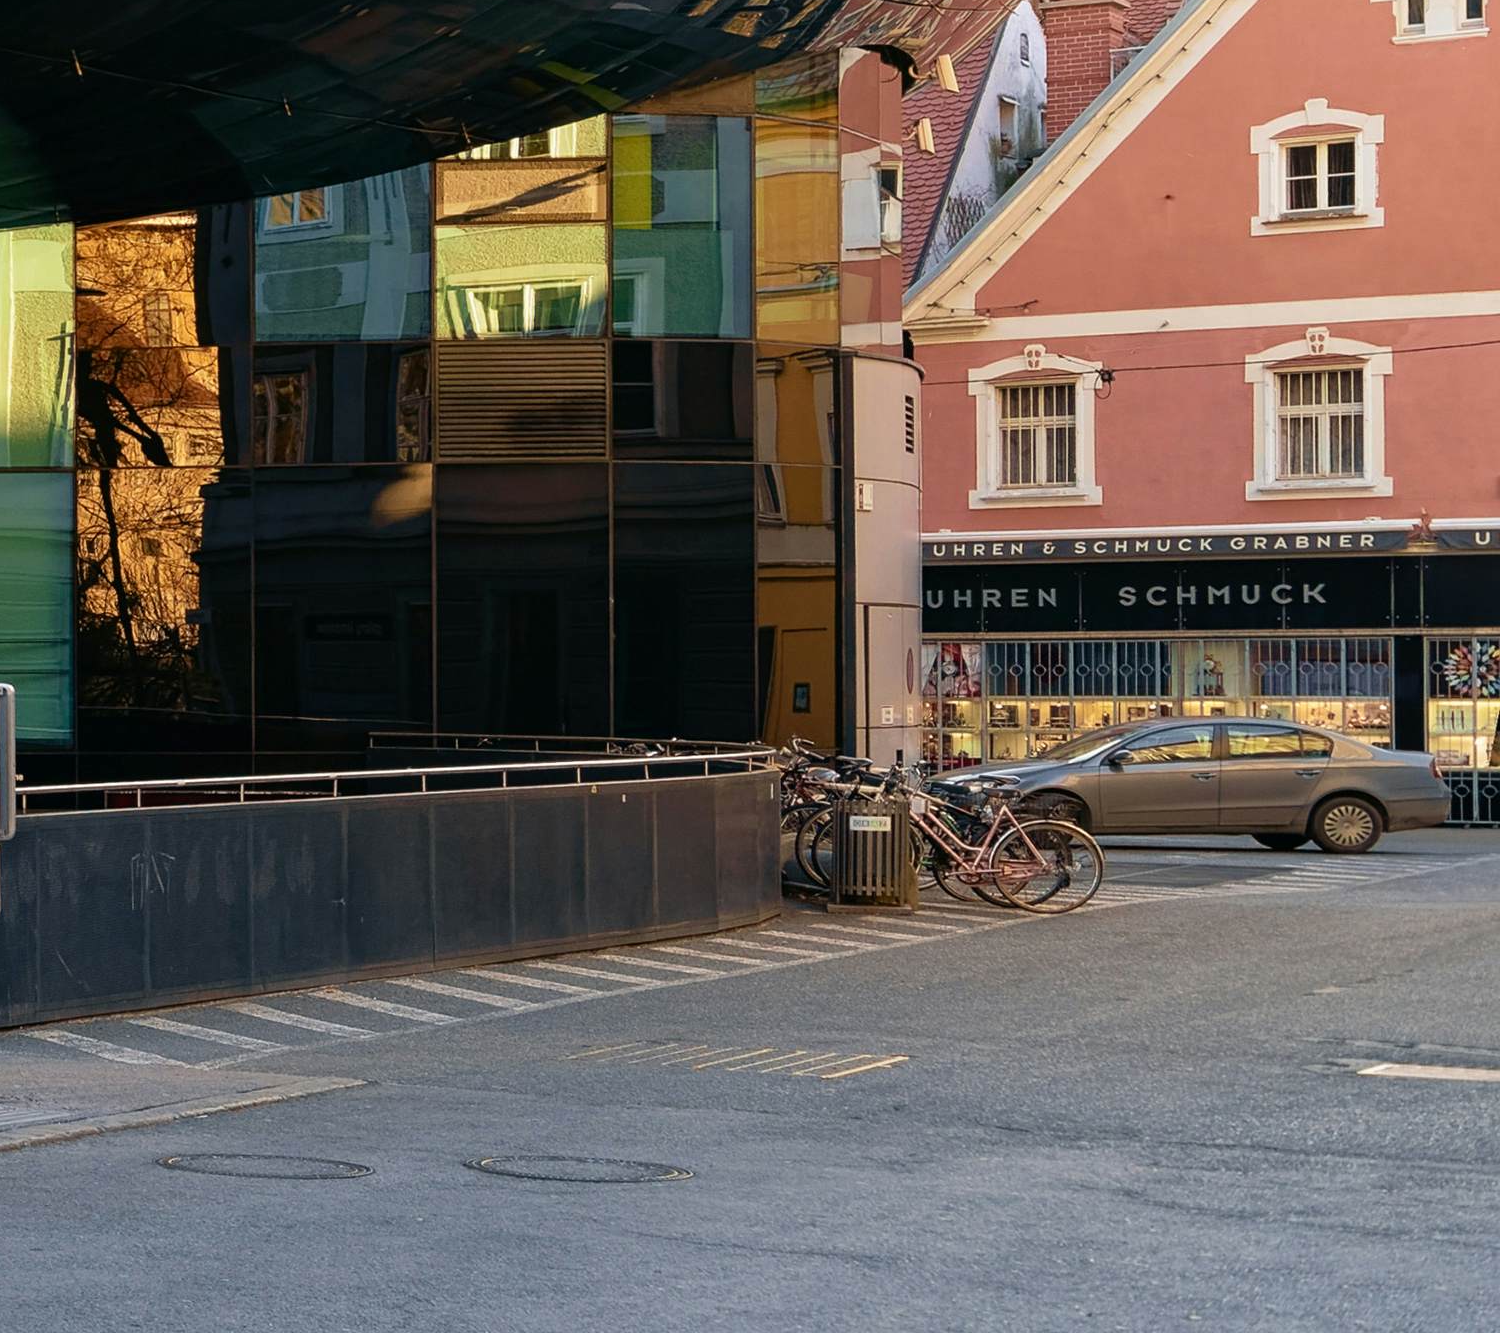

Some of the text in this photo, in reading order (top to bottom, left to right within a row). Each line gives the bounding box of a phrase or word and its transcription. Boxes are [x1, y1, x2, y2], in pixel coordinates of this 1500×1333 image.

[932, 533, 1375, 557] UHREN & SCHMUCK GRABNER
[927, 583, 1327, 609] UHREN SCHMUCK
